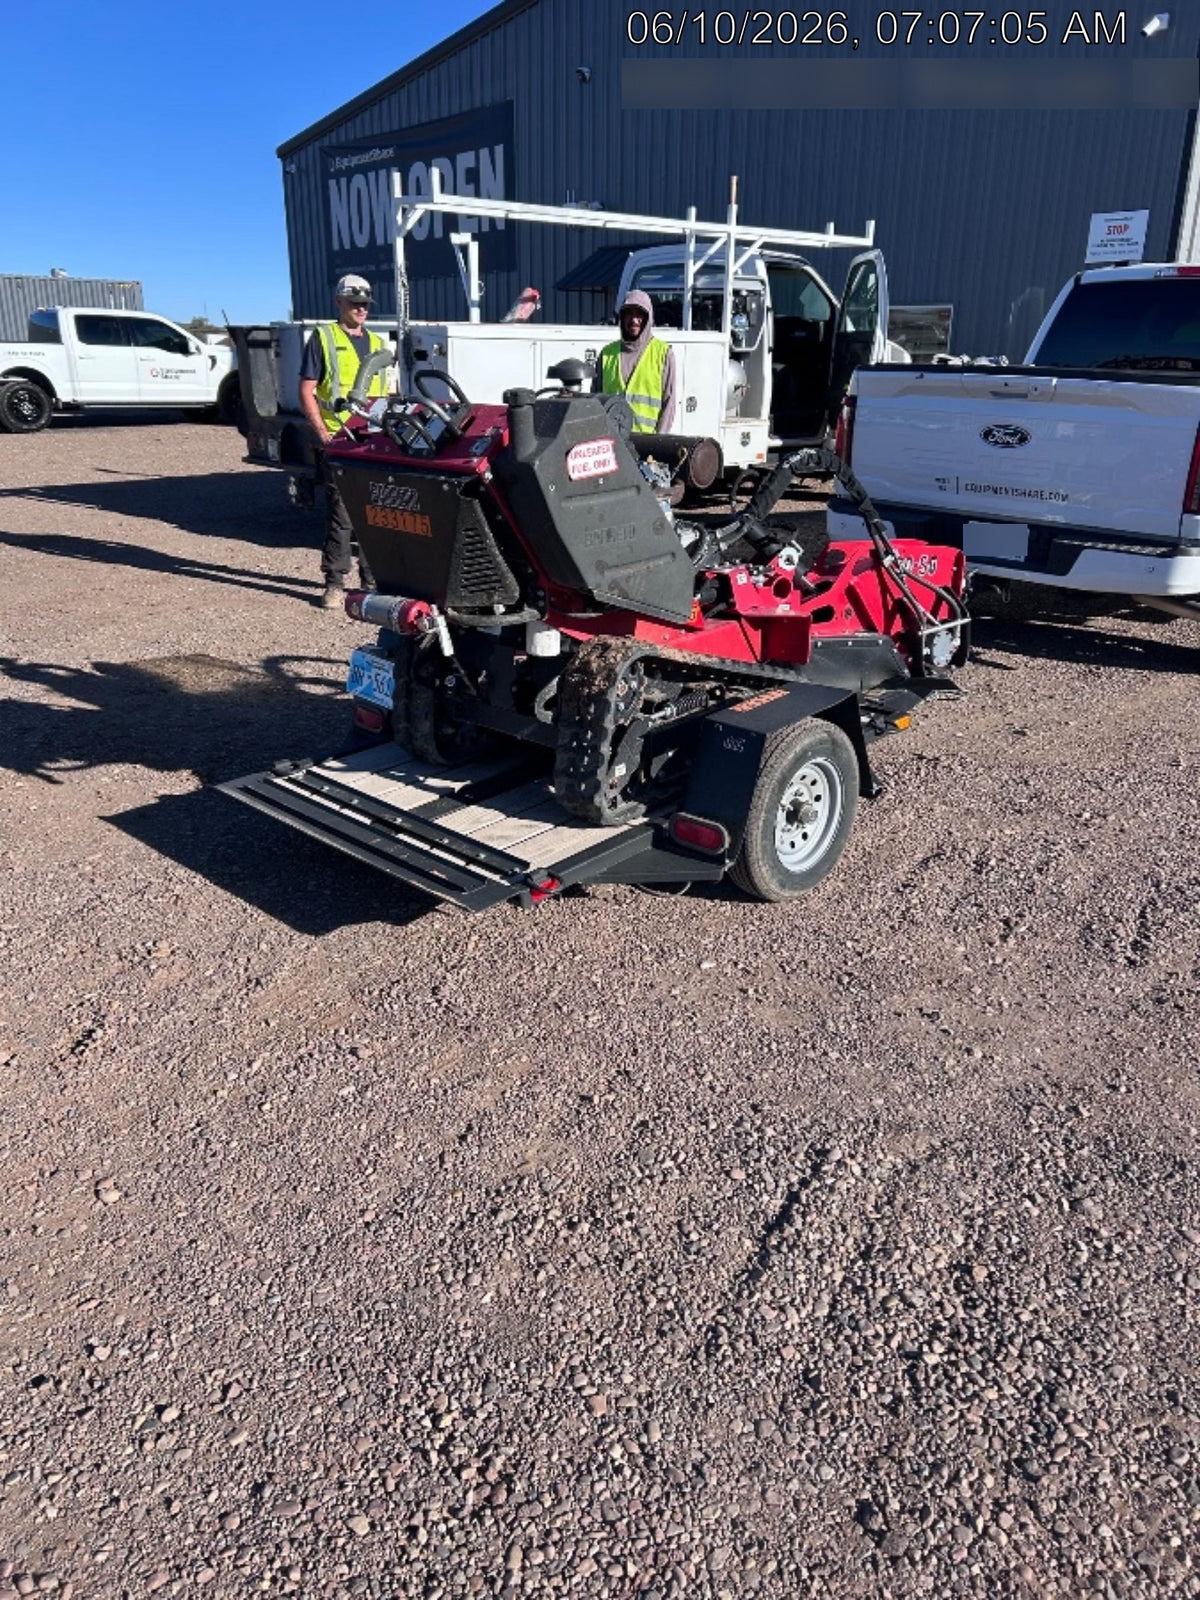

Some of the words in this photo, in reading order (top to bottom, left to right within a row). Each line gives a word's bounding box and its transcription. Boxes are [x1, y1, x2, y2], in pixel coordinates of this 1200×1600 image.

[328, 167, 401, 250] NOW
[408, 143, 505, 241] OPEN
[1106, 223, 1130, 235] STOP
[964, 482, 1069, 503] EQUIPMENTSHARE.COM
